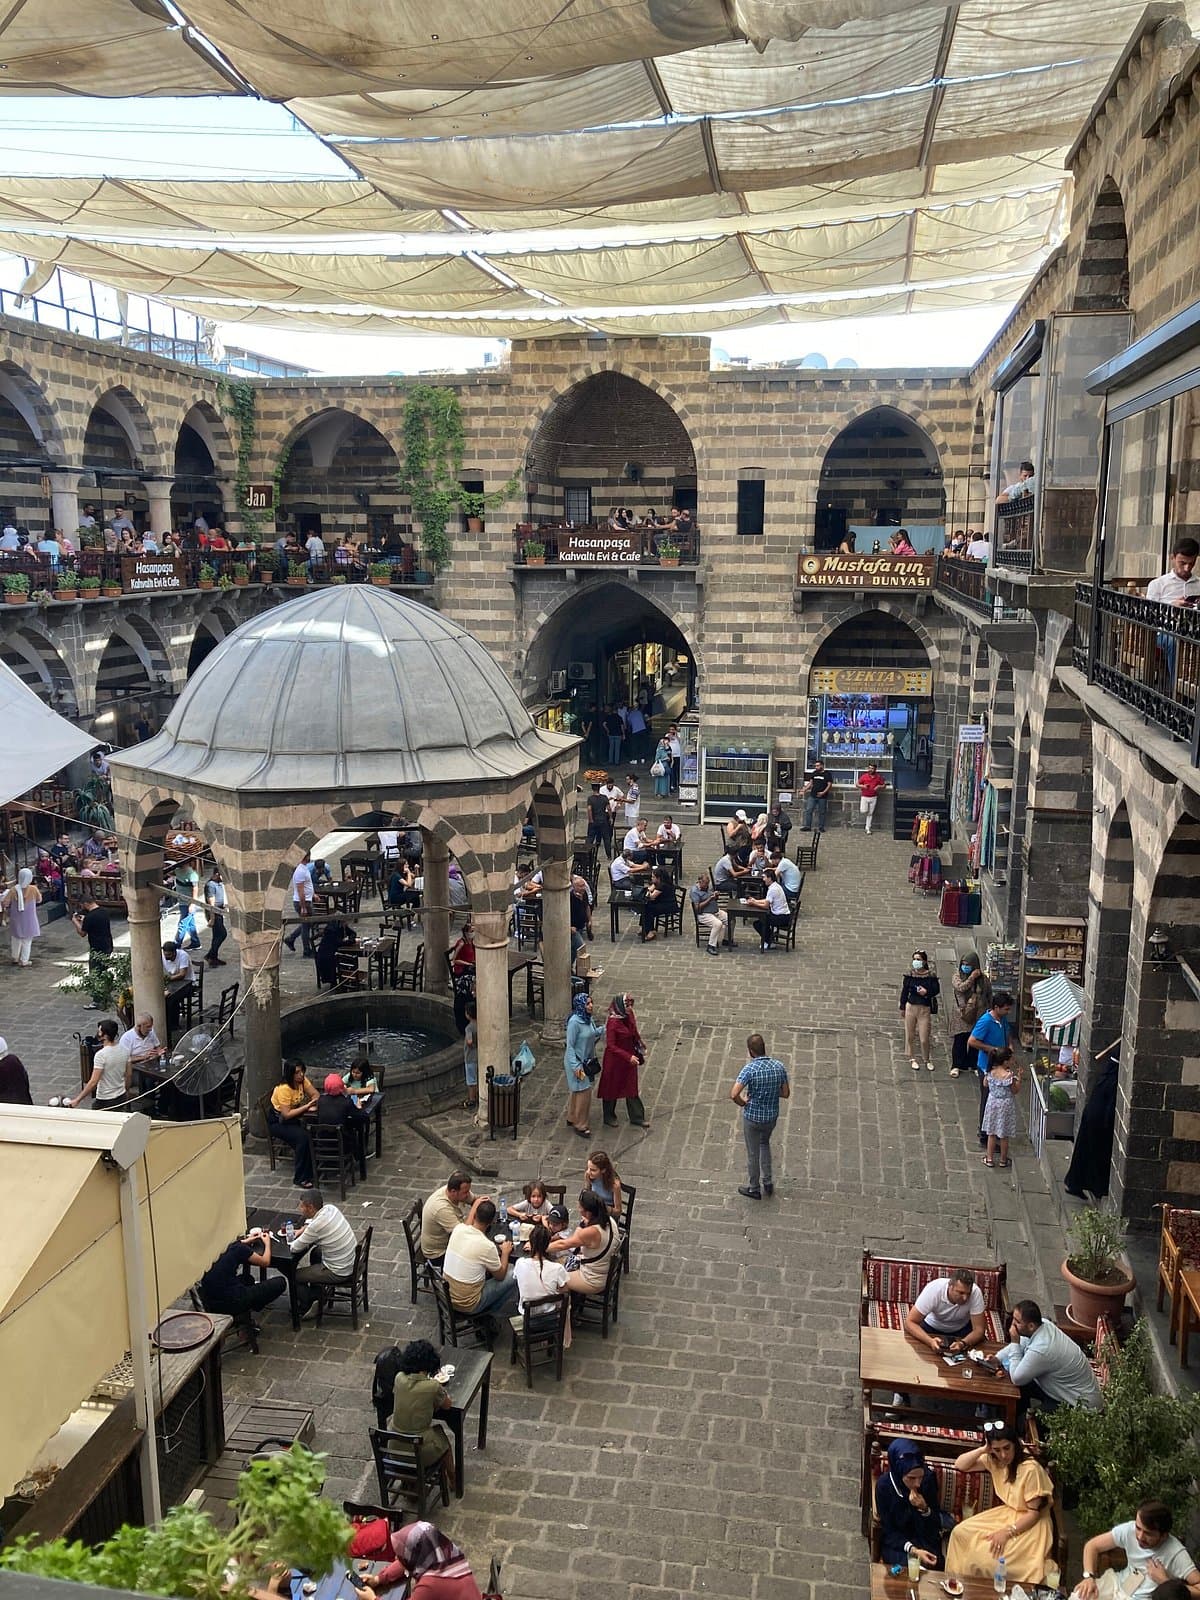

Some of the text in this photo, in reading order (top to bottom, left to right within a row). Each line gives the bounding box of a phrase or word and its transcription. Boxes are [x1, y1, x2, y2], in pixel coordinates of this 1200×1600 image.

[246, 486, 266, 507] Jan
[568, 537, 631, 550] Hasanpaşa
[559, 551, 641, 561] Kahvaltı Evi & Cafe
[135, 562, 174, 576] Hasanpaşa
[823, 556, 890, 575] Mustafa
[800, 574, 864, 585] KAHVALTI
